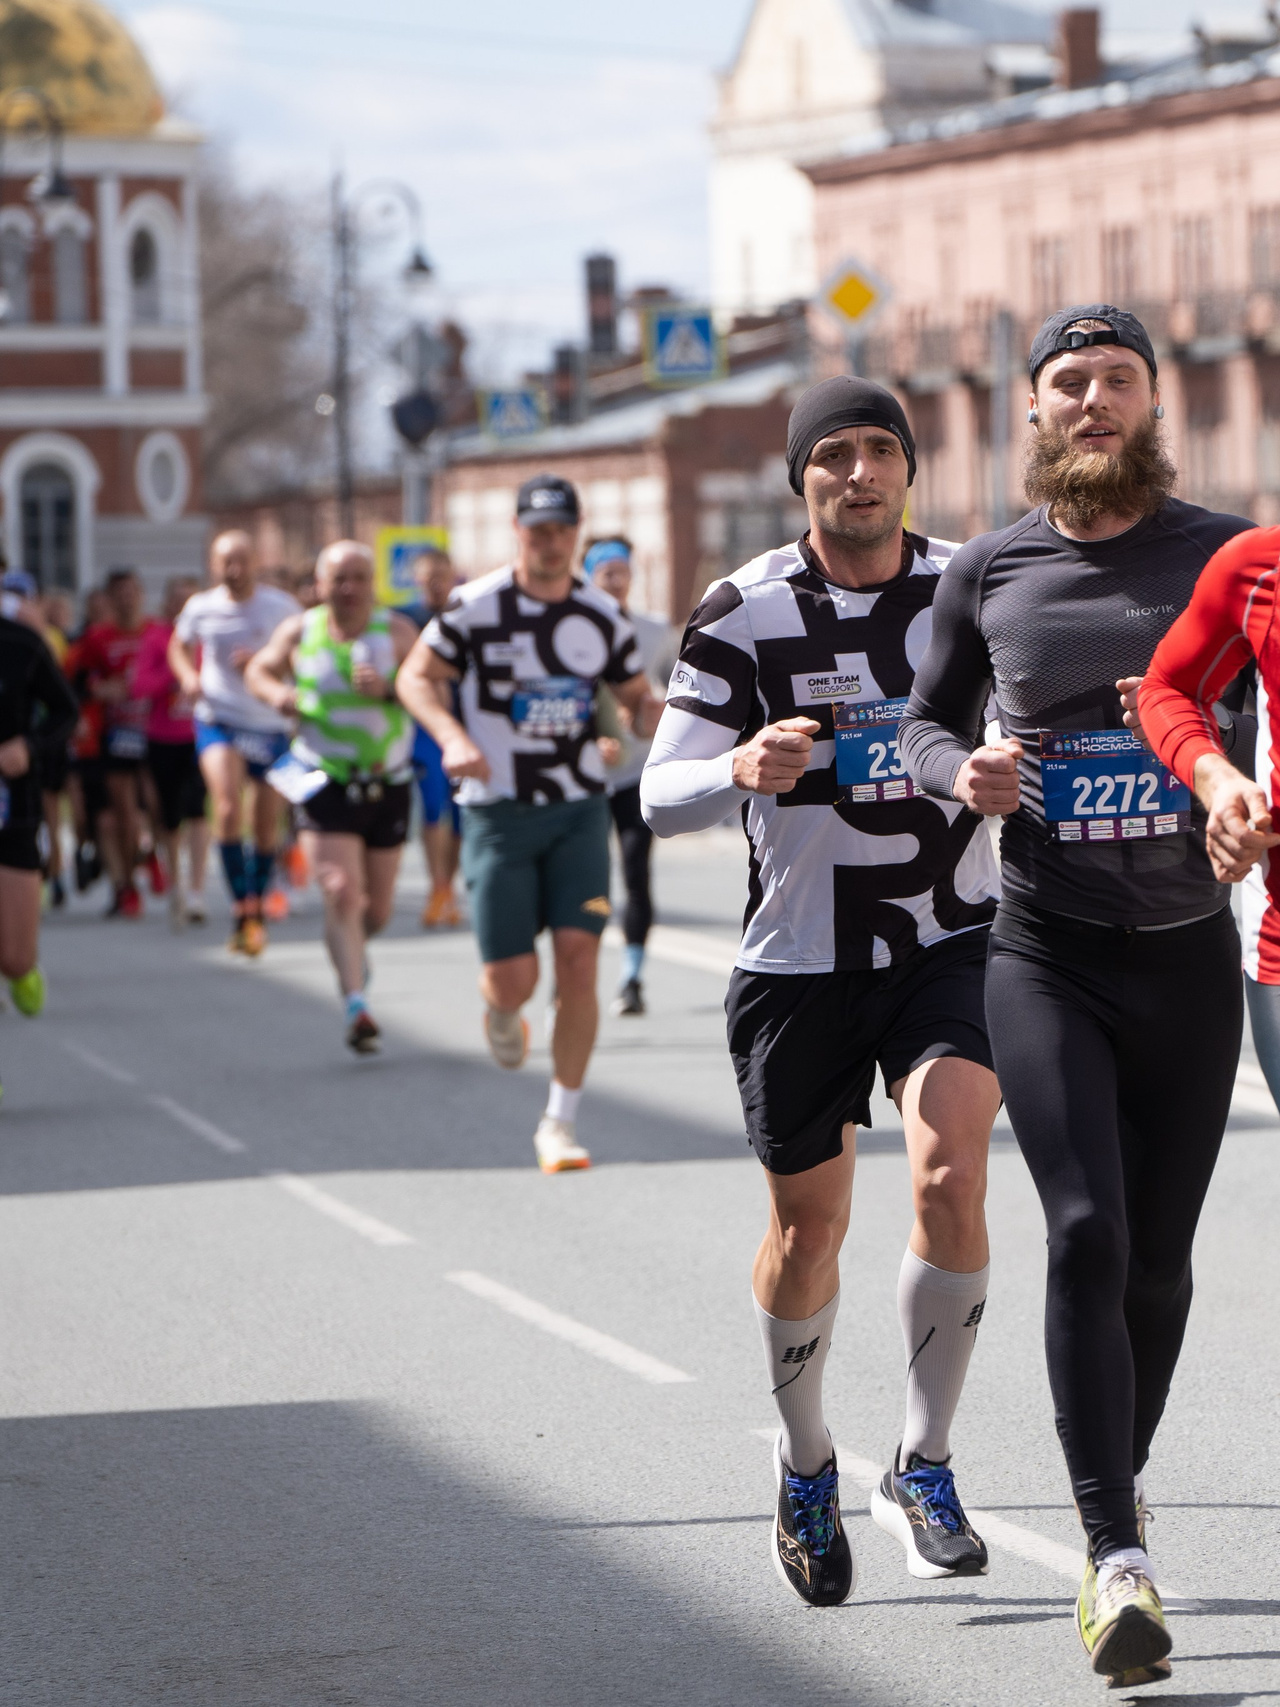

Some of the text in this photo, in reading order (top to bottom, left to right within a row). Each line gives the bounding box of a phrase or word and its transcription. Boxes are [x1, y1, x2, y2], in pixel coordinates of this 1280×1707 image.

[1126, 604, 1176, 618] INOVIK
[807, 675, 860, 687] ONE TEAM
[809, 684, 855, 695] VELOSPORT
[1081, 742, 1142, 752] КОСМОС
[867, 740, 908, 779] 23
[1072, 772, 1161, 816] 2272
